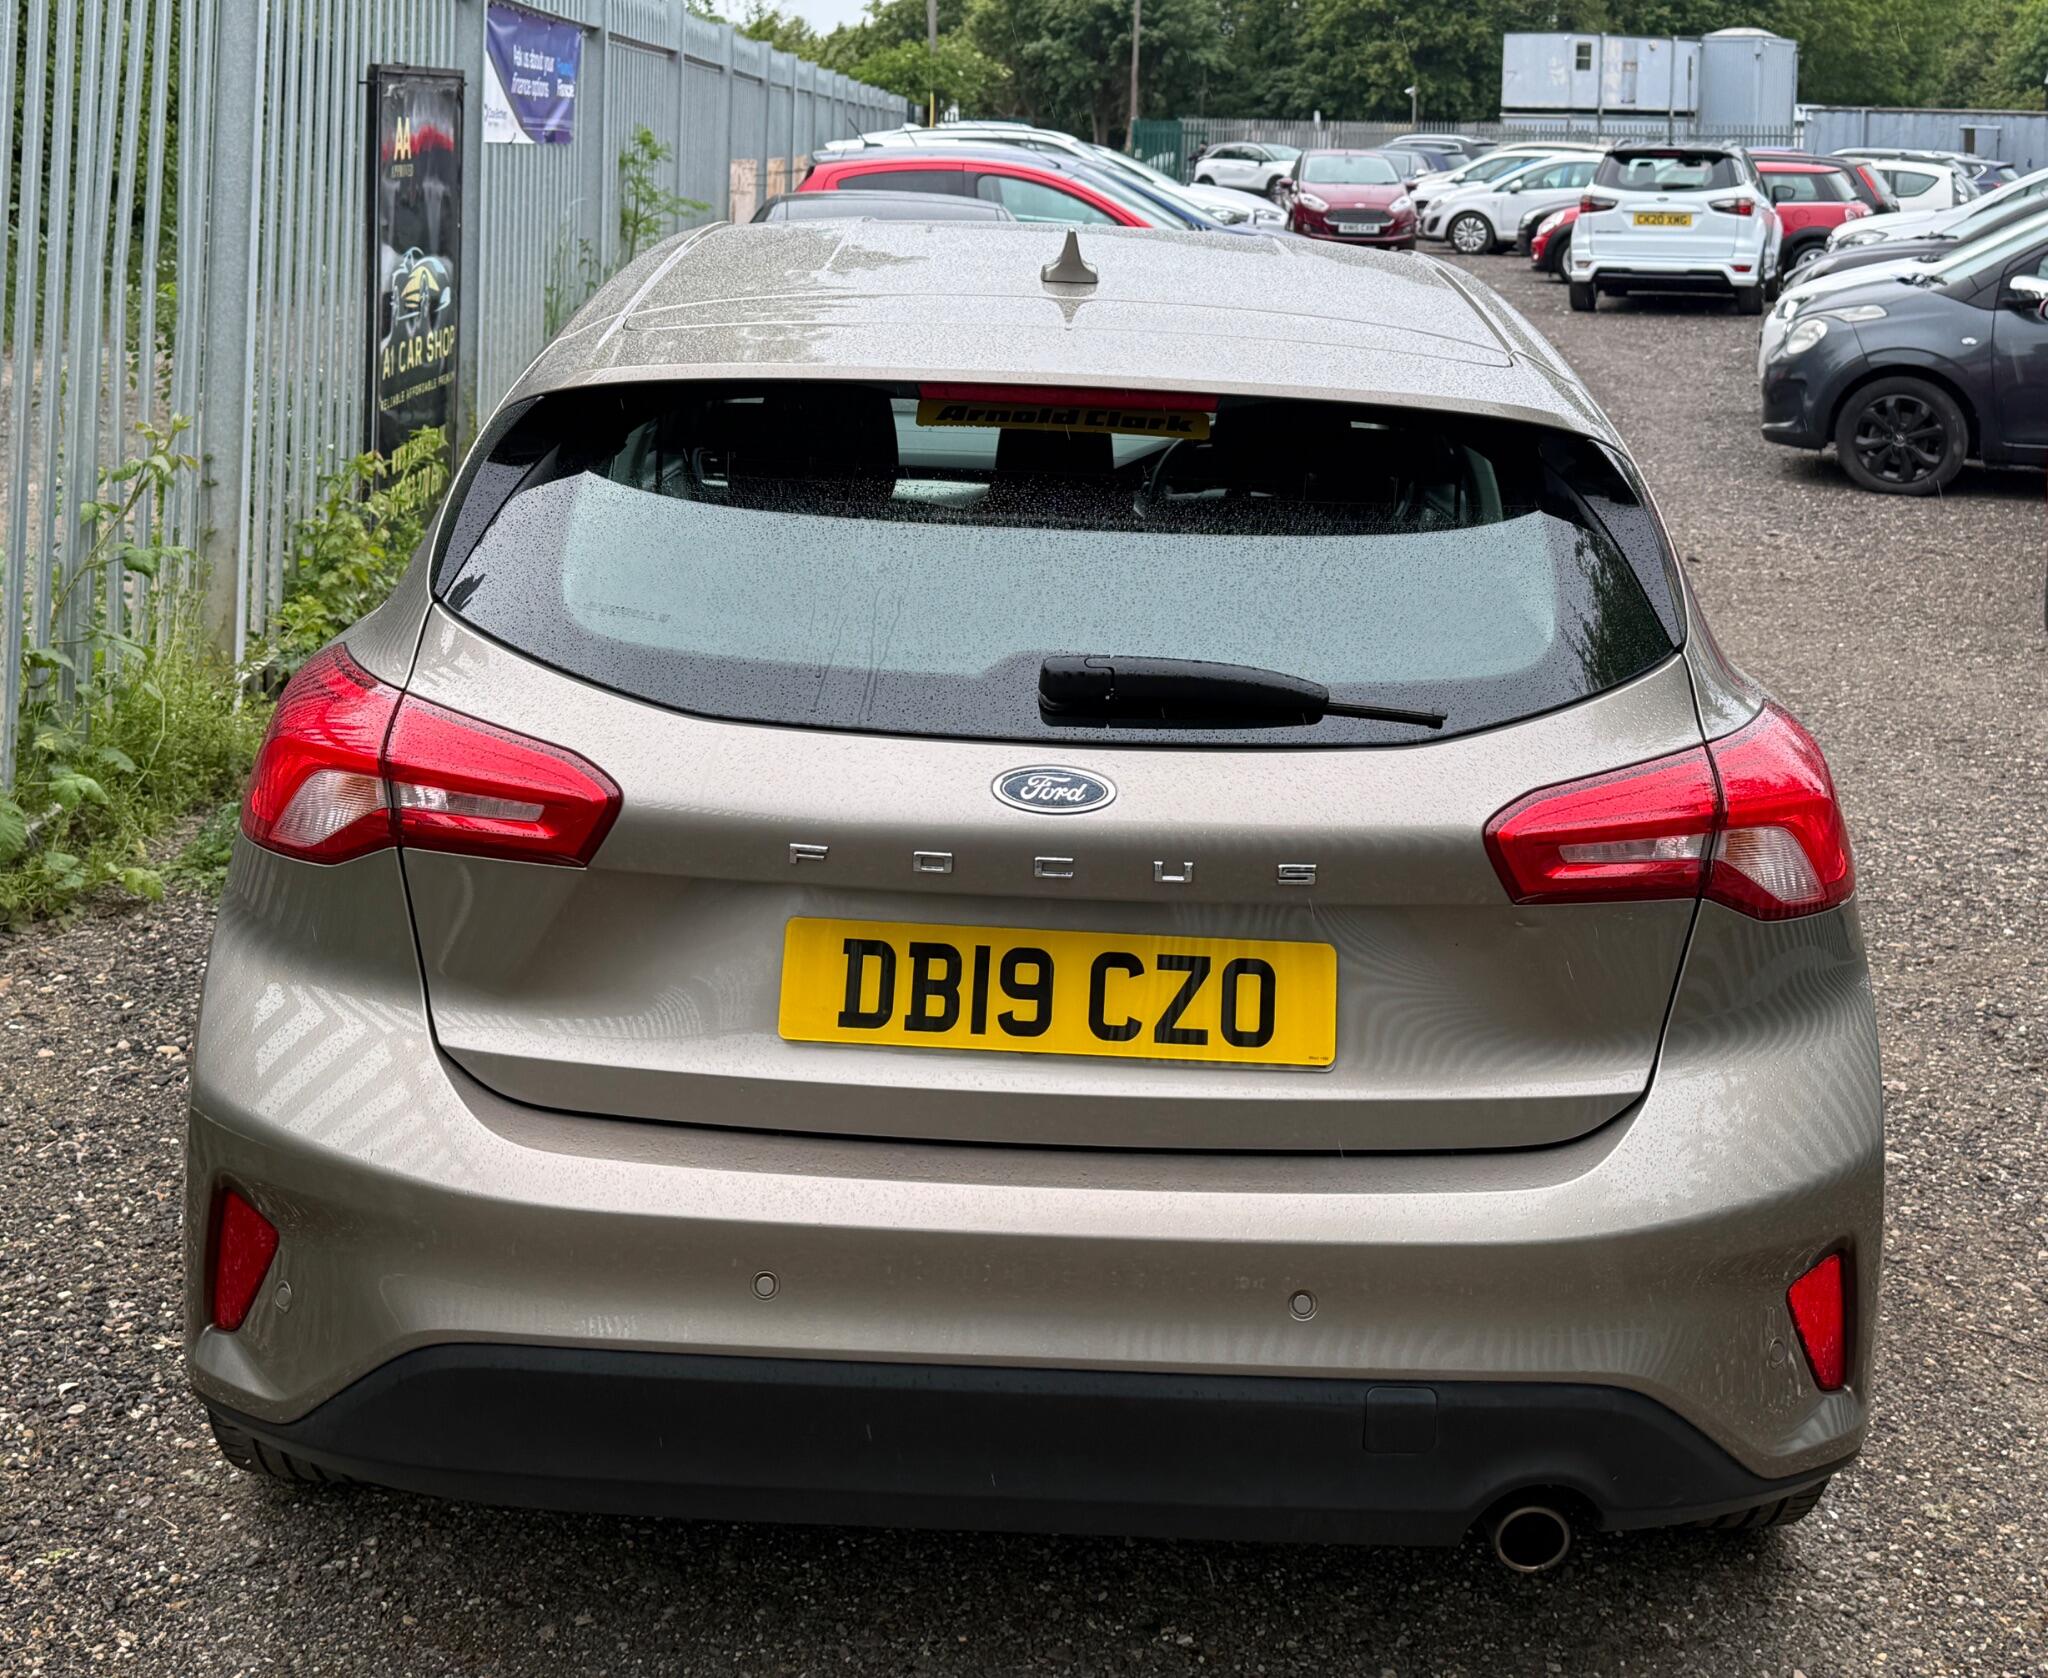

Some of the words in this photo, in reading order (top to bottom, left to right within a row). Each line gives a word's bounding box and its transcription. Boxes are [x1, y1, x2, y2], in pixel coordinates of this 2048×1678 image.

[393, 116, 412, 160] AA
[382, 345, 395, 380] A1
[399, 335, 423, 373] CAR
[426, 325, 456, 362] SHOP
[935, 405, 1081, 426] Arnold
[1084, 410, 1194, 433] Clark
[1020, 775, 1088, 802] Ford
[789, 842, 1318, 886] FOCUS
[837, 938, 1055, 1038] DB19
[1088, 951, 1276, 1049] CZO
